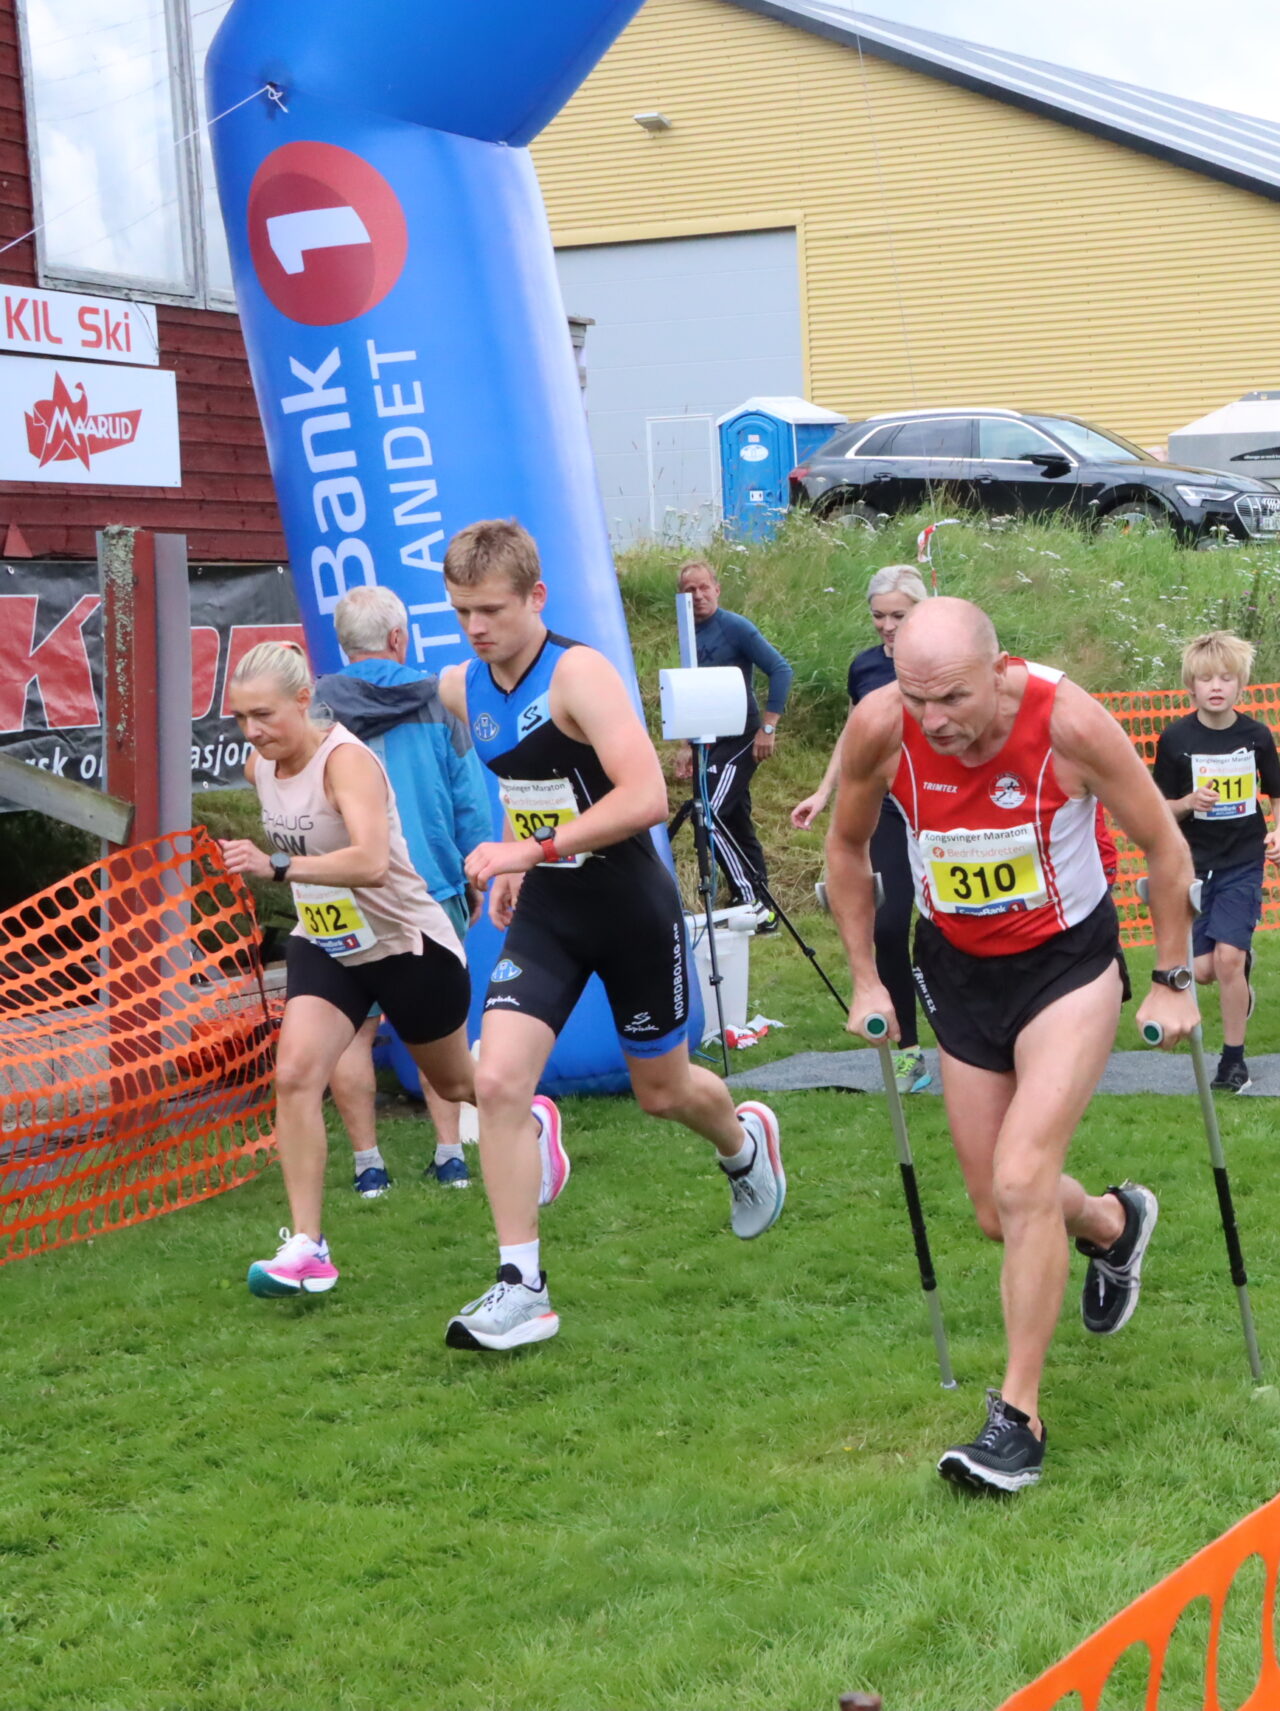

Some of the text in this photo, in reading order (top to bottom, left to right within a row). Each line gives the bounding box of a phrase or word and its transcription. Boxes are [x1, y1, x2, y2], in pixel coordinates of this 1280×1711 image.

[5, 296, 132, 352] KIL Ski
[47, 406, 133, 446] MAARUD
[266, 206, 379, 668] Bank 1
[367, 339, 461, 664] TLANDET
[190, 736, 257, 776] asjon
[922, 781, 959, 793] TRIMTEX
[262, 809, 314, 831] HAUG
[924, 828, 1028, 844] Kongsvinger Maraton
[950, 863, 1016, 900] 310
[304, 904, 348, 934] 312
[912, 966, 937, 1014] TRIMTEX
